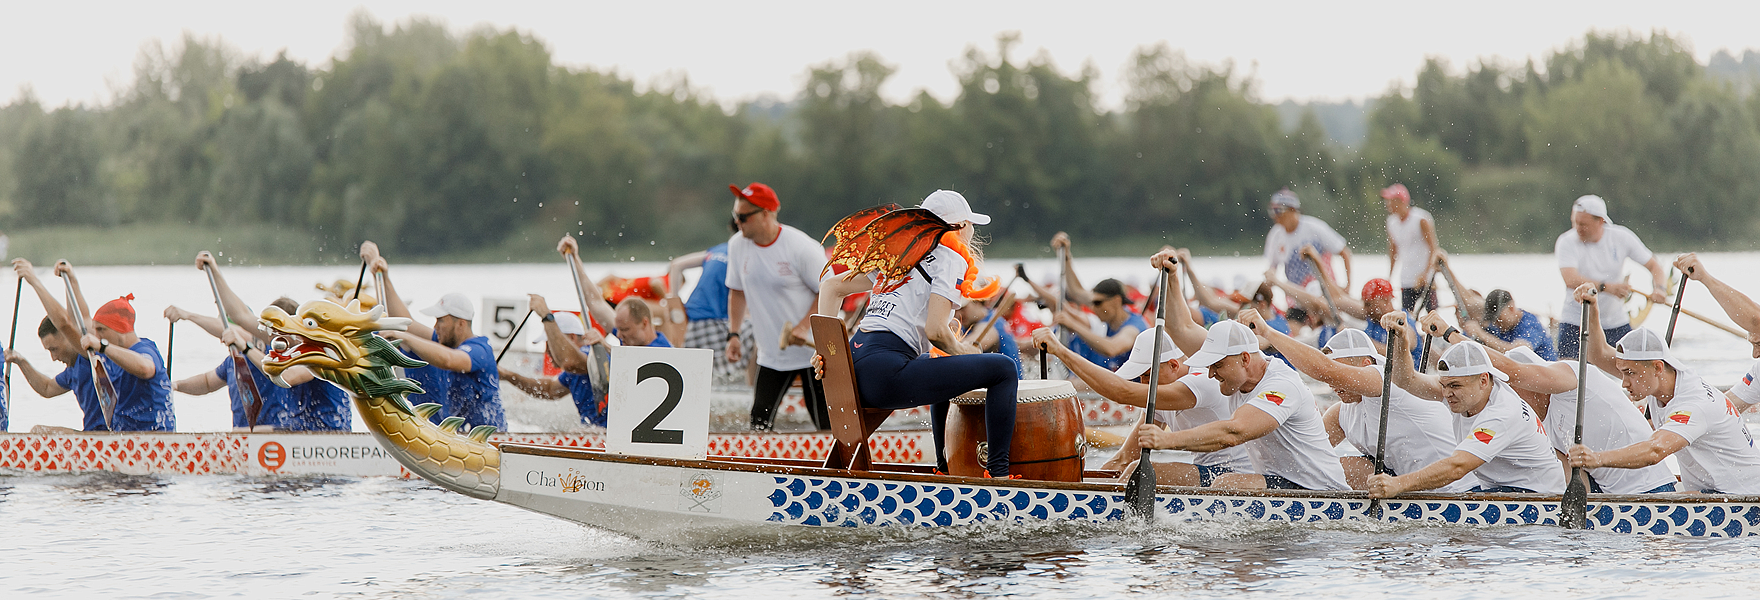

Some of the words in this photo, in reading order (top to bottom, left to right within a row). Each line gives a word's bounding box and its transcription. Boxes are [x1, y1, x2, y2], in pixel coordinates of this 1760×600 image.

[494, 306, 516, 339] 5
[631, 362, 684, 445] 2
[526, 469, 605, 493] Chapion
